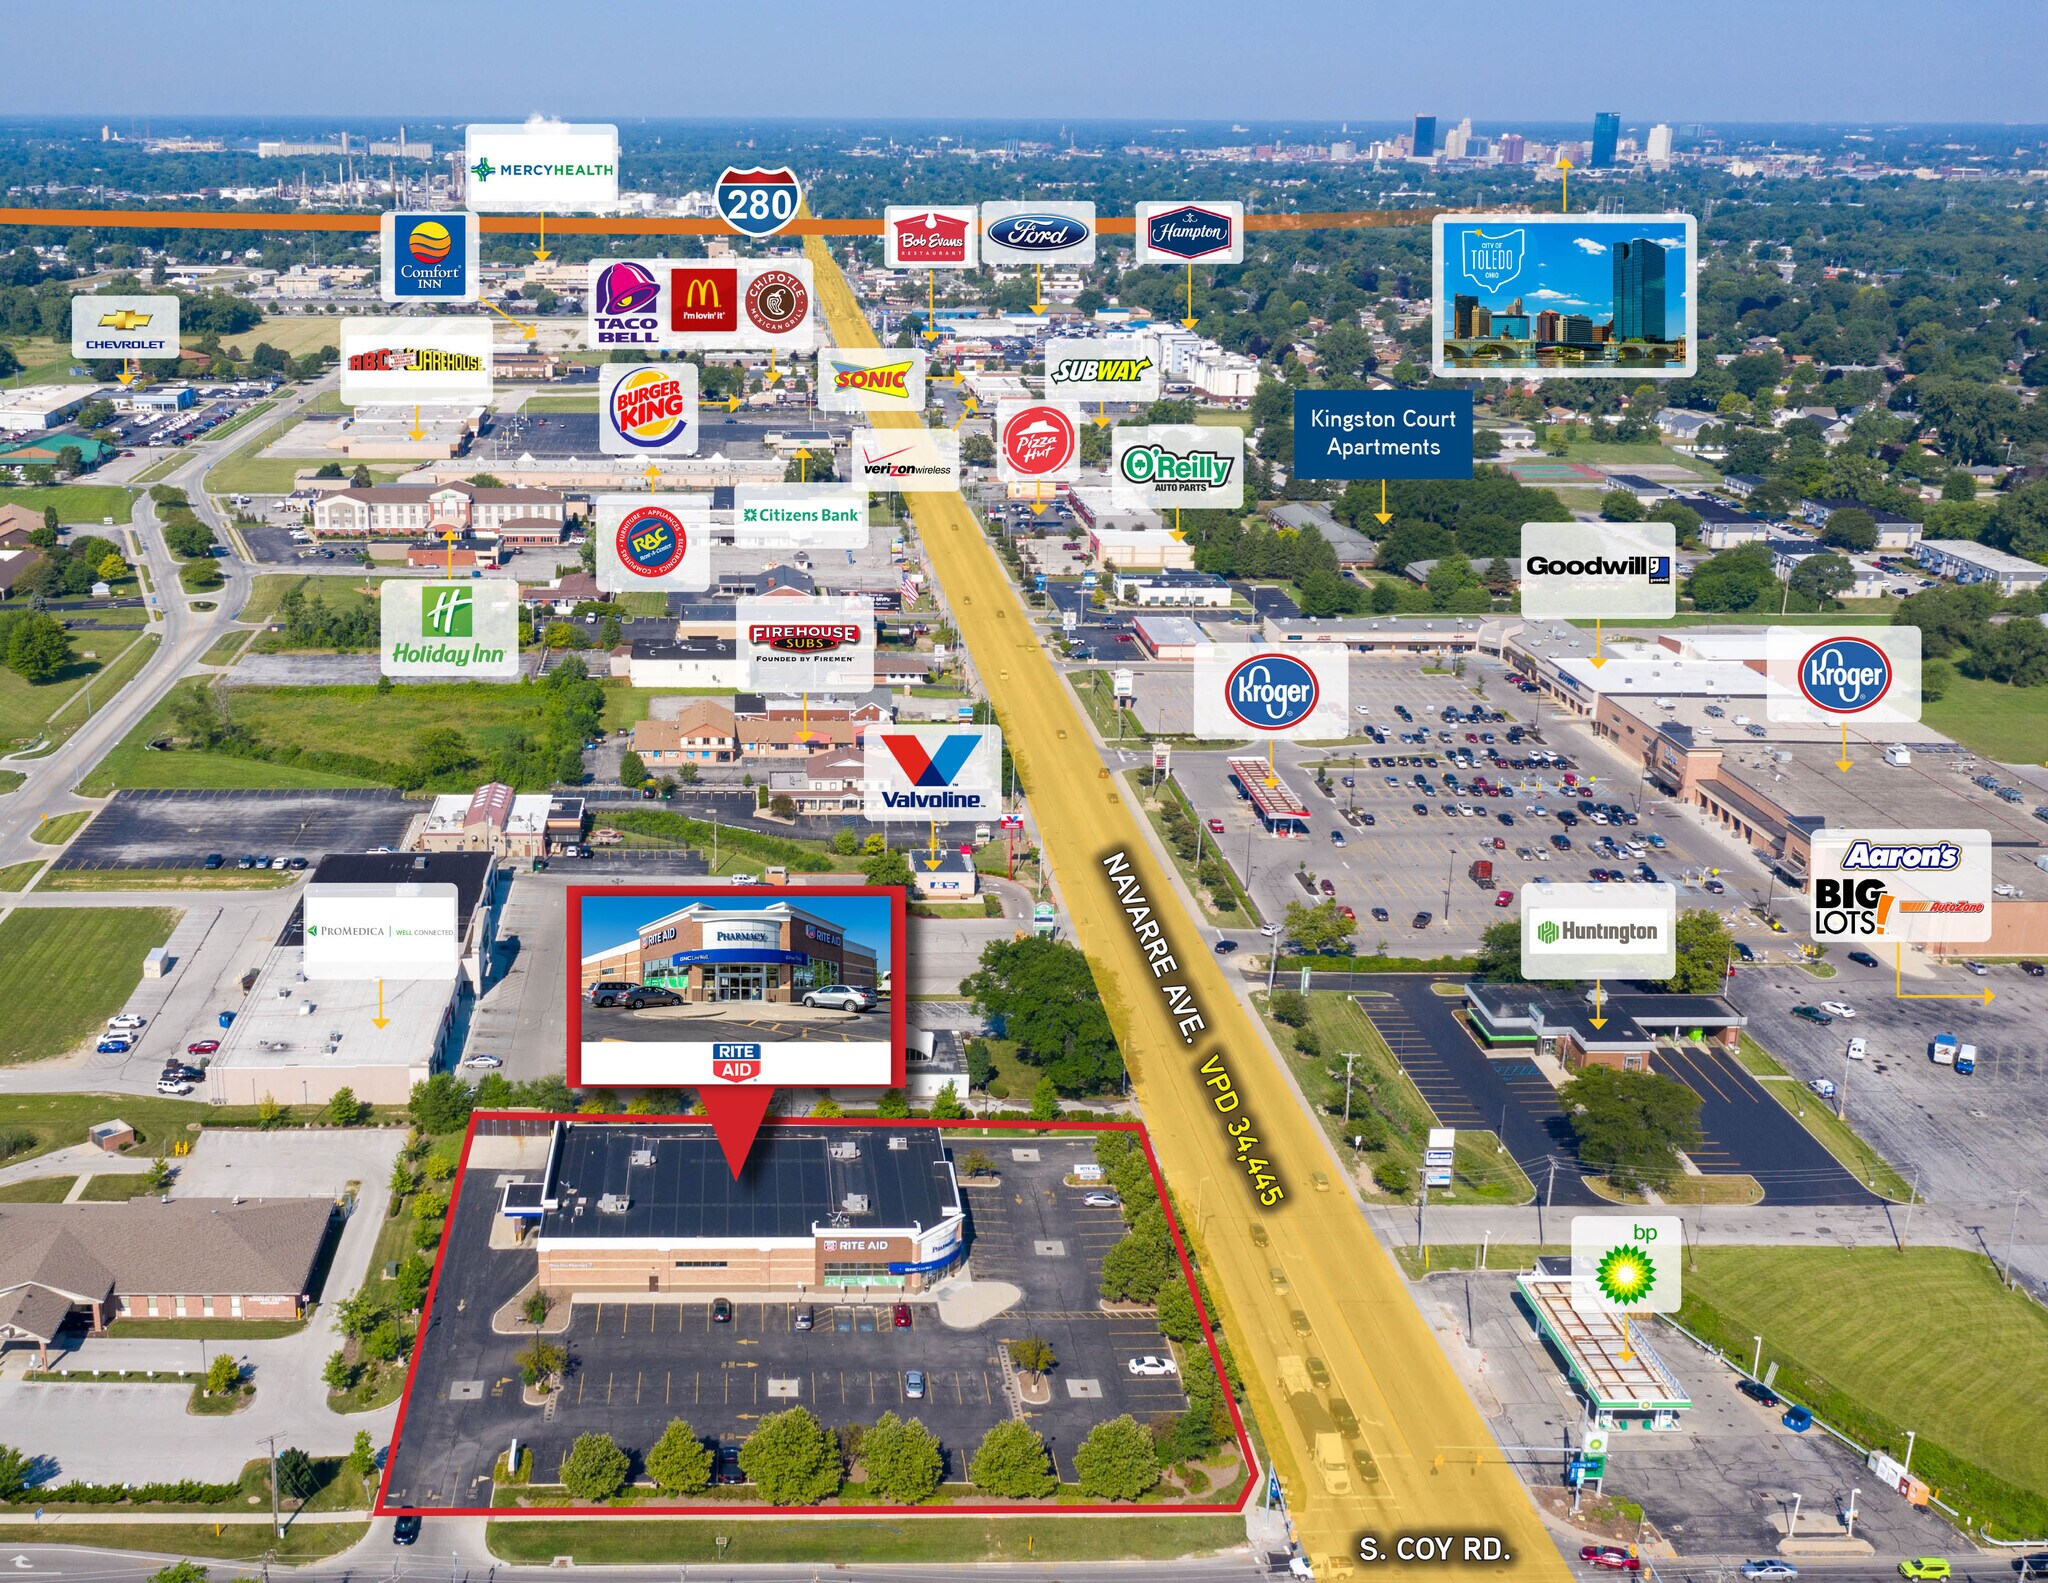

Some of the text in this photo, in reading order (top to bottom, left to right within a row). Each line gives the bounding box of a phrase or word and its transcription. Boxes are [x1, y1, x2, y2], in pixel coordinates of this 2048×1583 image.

[648, 930, 664, 945] RITE
[664, 927, 677, 941] AID
[816, 930, 830, 944] RITE
[831, 936, 841, 946] AID
[840, 1241, 865, 1250] RITE
[868, 1241, 888, 1250] AID
